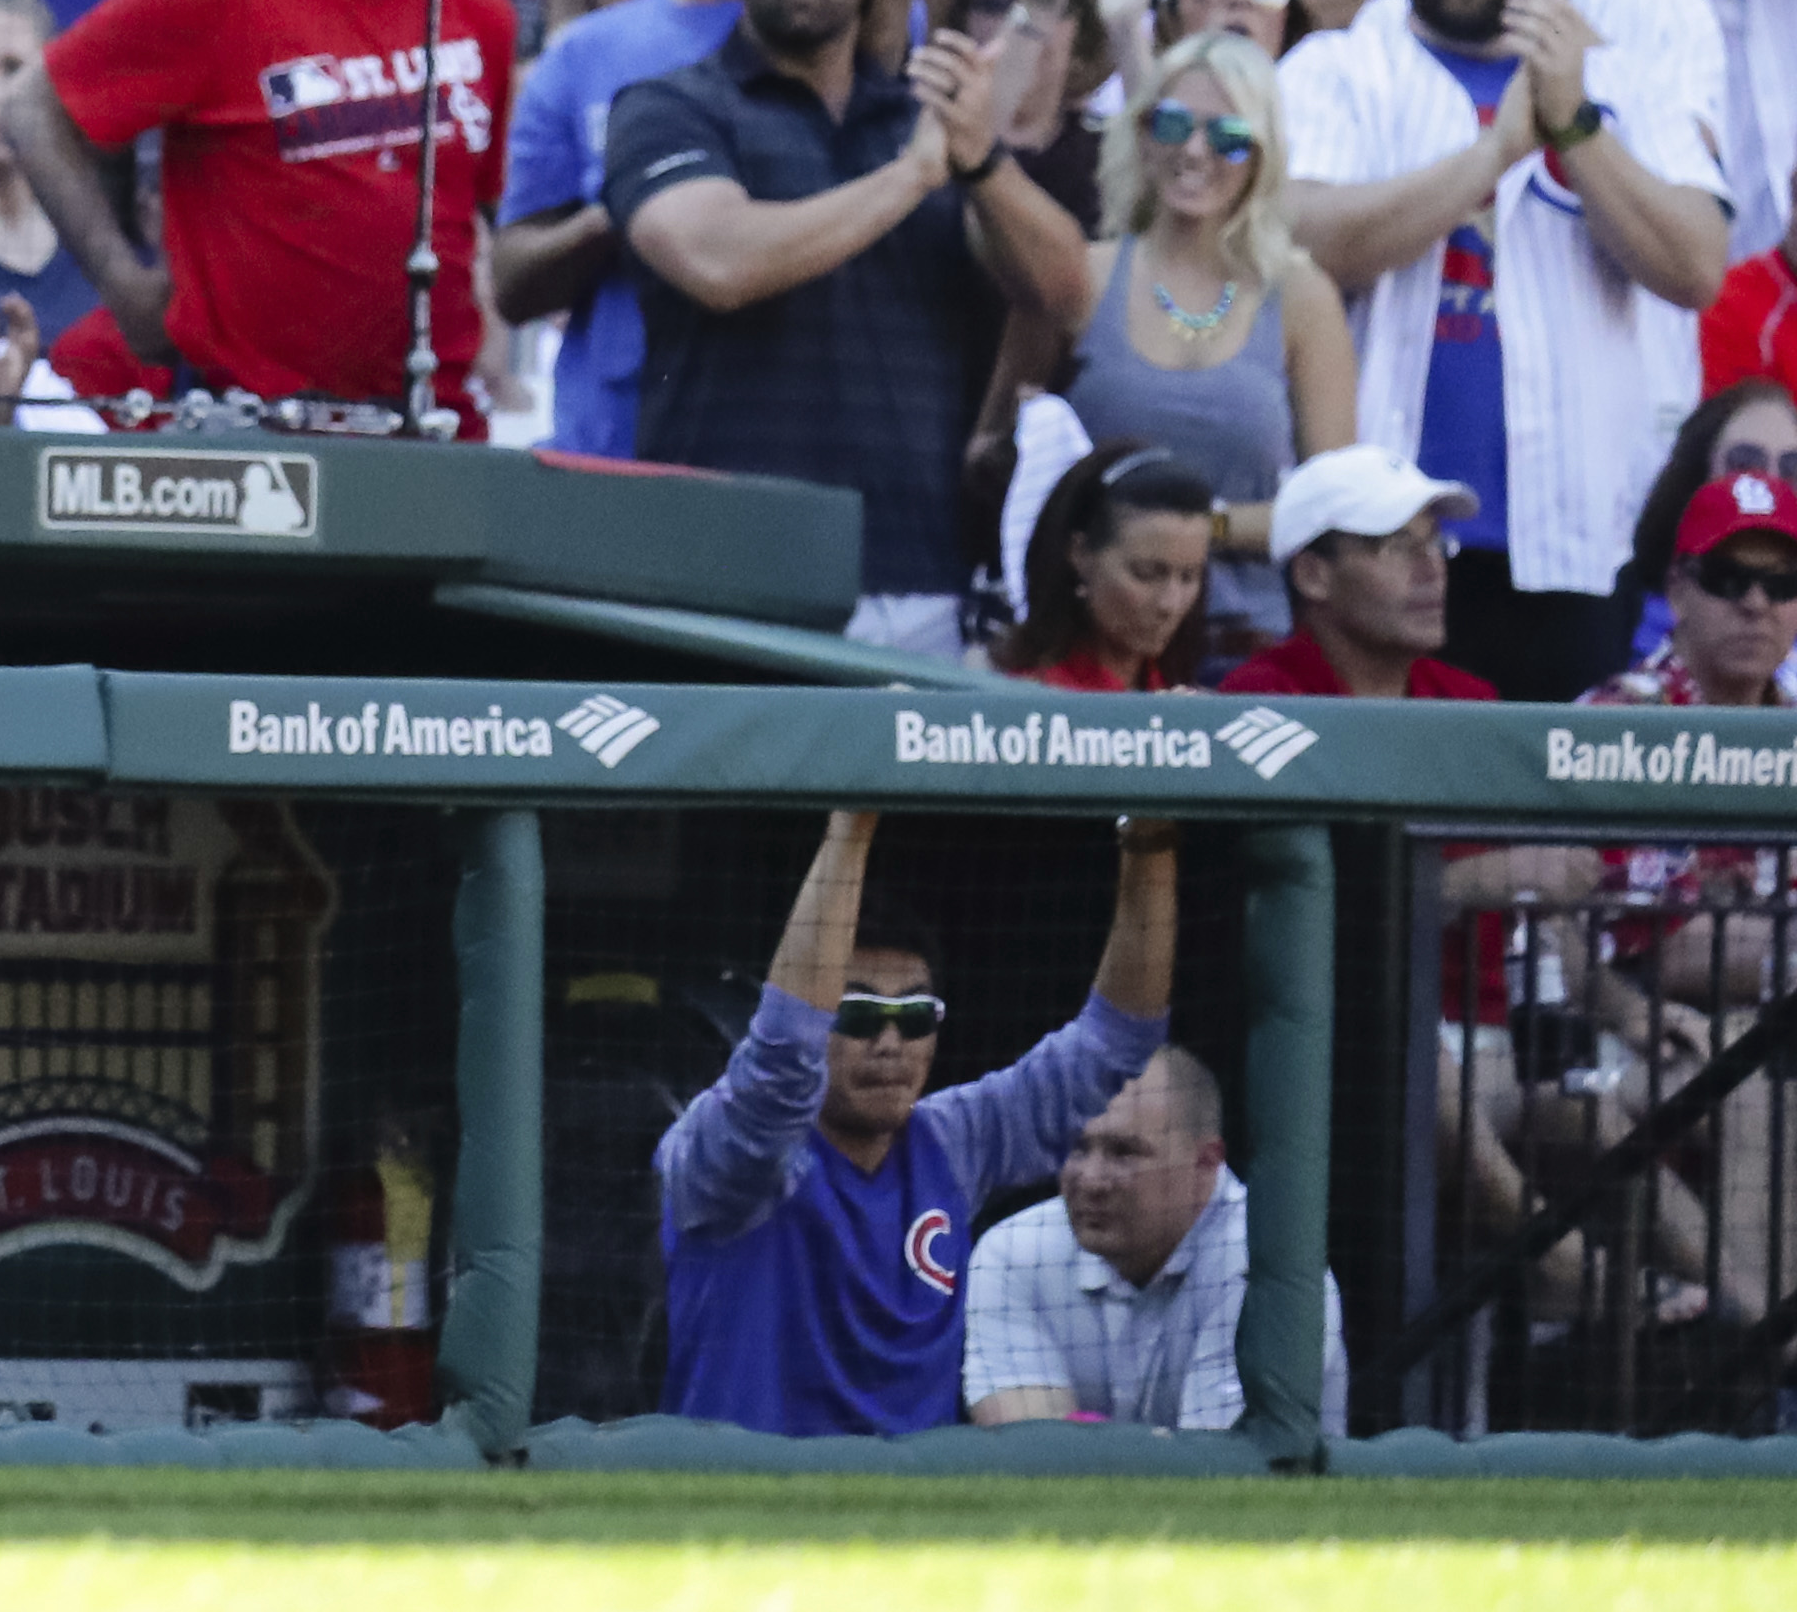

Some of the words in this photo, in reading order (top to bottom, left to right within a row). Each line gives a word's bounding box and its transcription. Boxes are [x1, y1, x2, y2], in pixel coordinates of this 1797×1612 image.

[53, 463, 238, 520] MLB.com
[228, 699, 334, 755] Bank
[336, 700, 381, 755] of
[383, 702, 554, 757] America
[895, 710, 999, 764] Bank
[999, 712, 1043, 766] of
[1045, 713, 1213, 768] America
[1546, 727, 1646, 783] Bank
[1647, 730, 1691, 785] of
[41, 1155, 188, 1233] LOUIS
